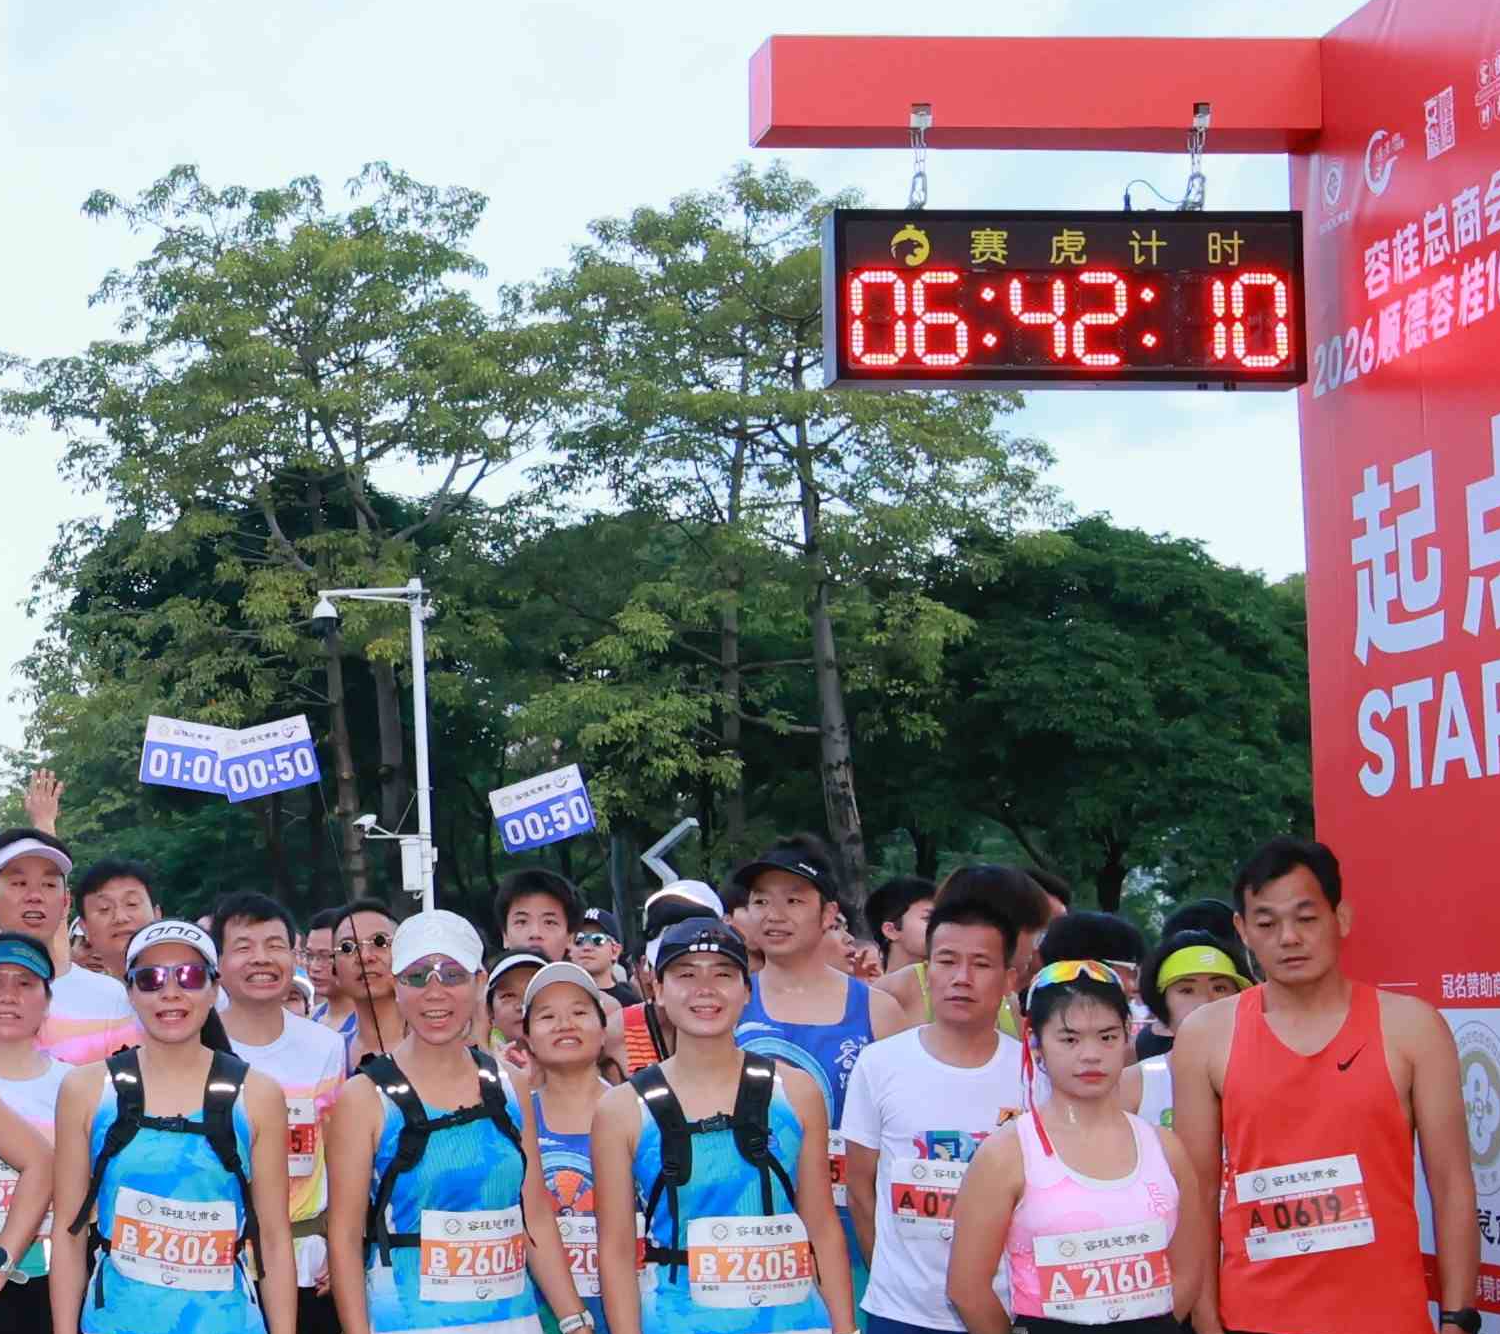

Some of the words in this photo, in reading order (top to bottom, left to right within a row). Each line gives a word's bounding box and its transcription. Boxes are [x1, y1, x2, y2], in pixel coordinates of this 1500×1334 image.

[970, 228, 1245, 265] 赛虎计时
[850, 271, 1289, 368] 06:42:10
[226, 747, 315, 795] 00:50
[504, 794, 590, 846] 00:50
[144, 1228, 219, 1266] 2606
[456, 1241, 517, 1276] 2604
[726, 1249, 798, 1282] 2605
[1081, 1259, 1154, 1299] 2160
